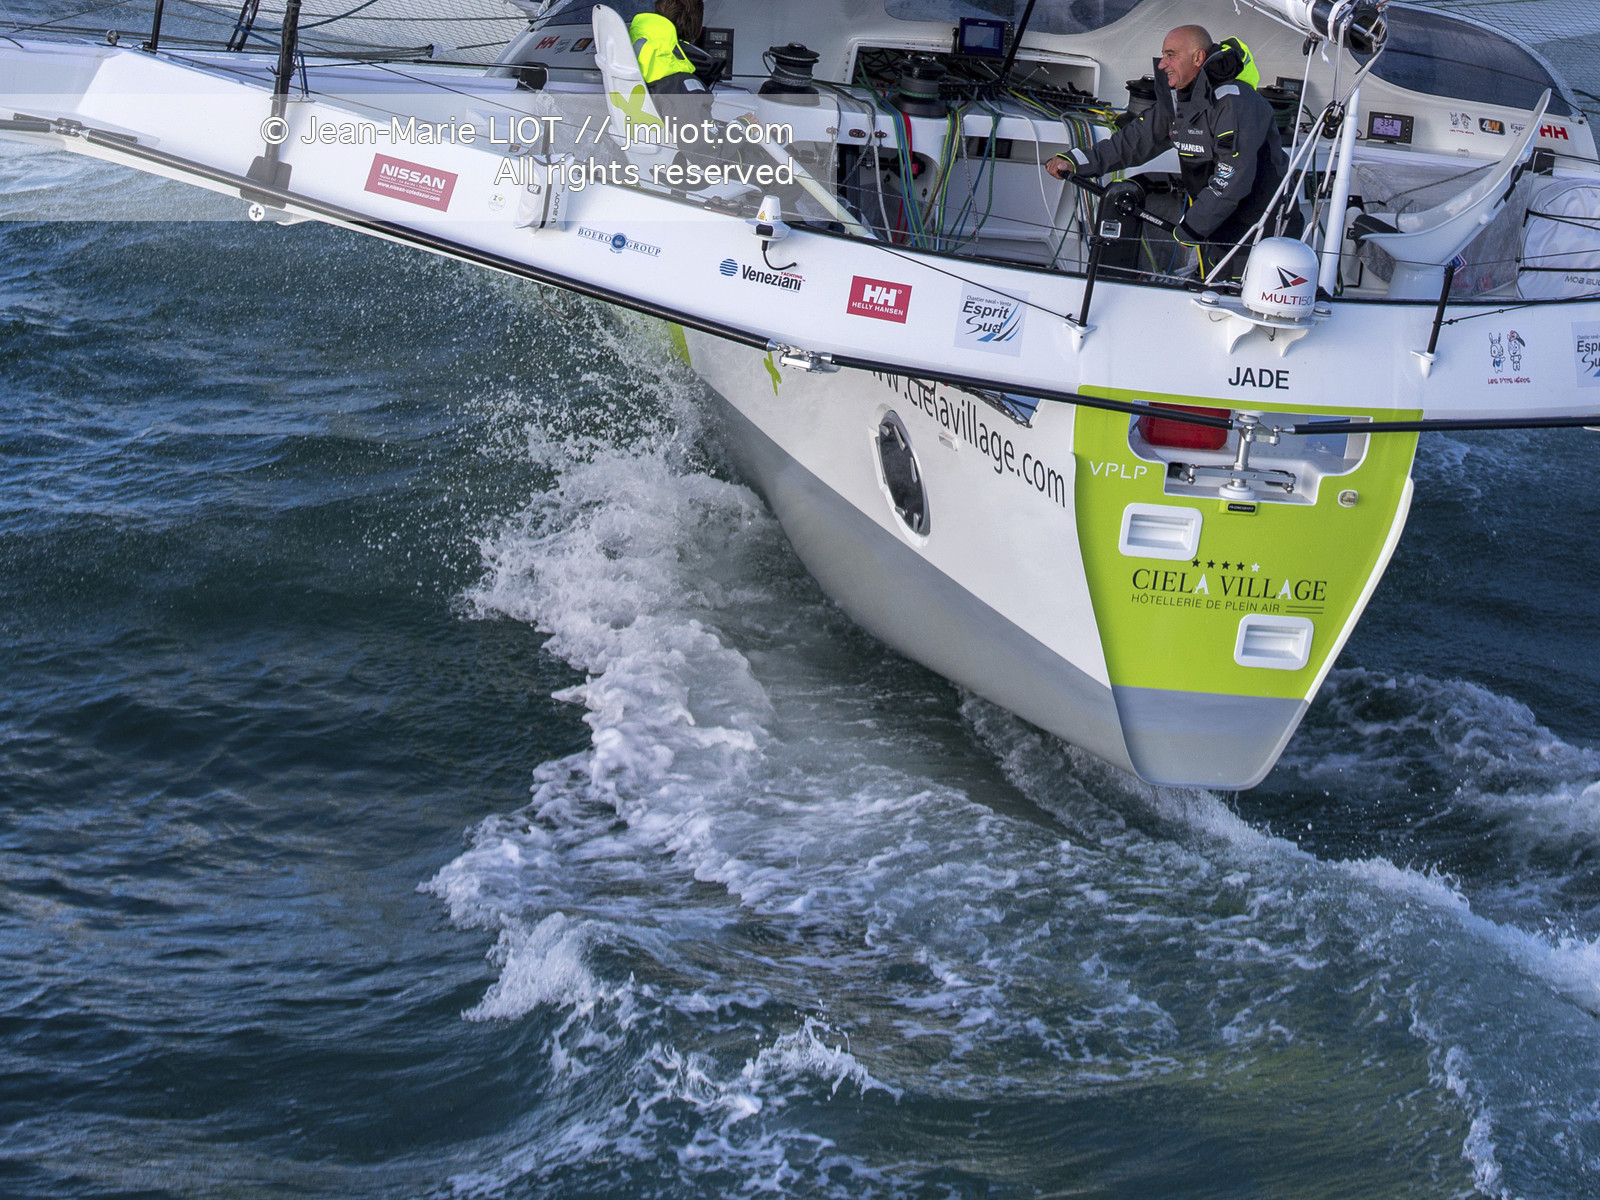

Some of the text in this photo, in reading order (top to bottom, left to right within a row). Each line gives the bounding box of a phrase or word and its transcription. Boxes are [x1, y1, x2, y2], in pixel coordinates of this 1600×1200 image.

[1539, 124, 1569, 141] HH
[1180, 142, 1205, 153] HANSEN
[381, 163, 446, 190] NISSAN
[578, 228, 661, 256] BOERO GROUP
[742, 264, 802, 291] Veneziani
[862, 283, 897, 307] HH
[852, 301, 904, 316] HELLY HANSEN
[962, 300, 1010, 320] Esprit
[965, 314, 1004, 335] Sud
[1228, 367, 1290, 390] JADE
[1089, 460, 1148, 480] VPLP
[1132, 568, 1328, 602] CIELA VILLAGE
[1131, 592, 1280, 613] HÔTELLERIE DE PLEIN AIR
